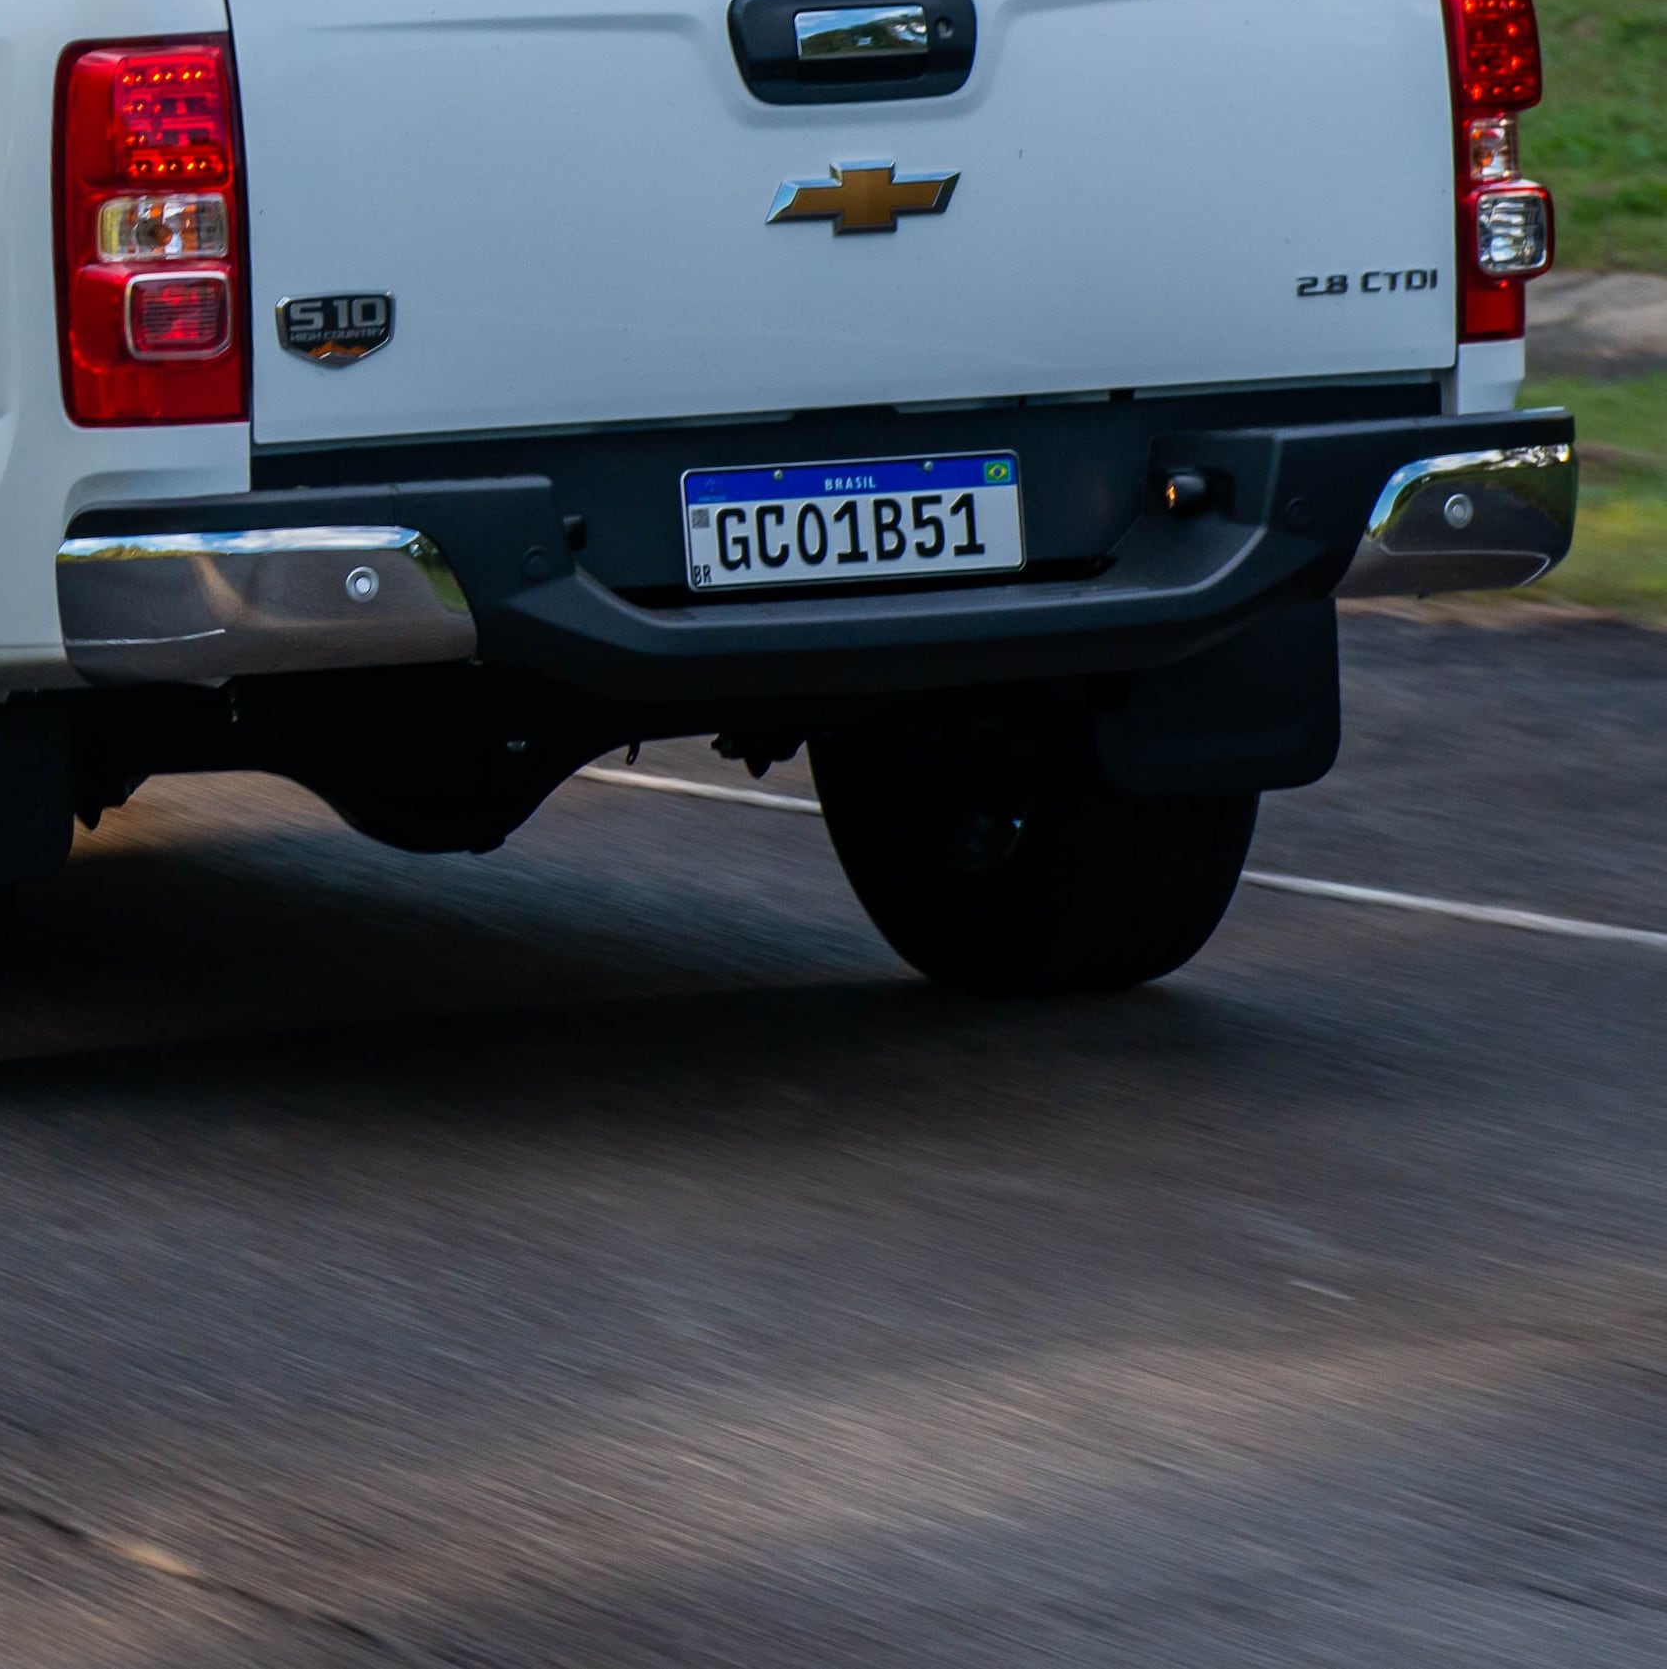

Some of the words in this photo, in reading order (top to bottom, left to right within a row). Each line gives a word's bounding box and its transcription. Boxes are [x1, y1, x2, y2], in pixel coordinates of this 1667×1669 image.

[1361, 268, 1438, 292] CTDI
[824, 475, 876, 492] BRASIL
[692, 565, 712, 586] BR
